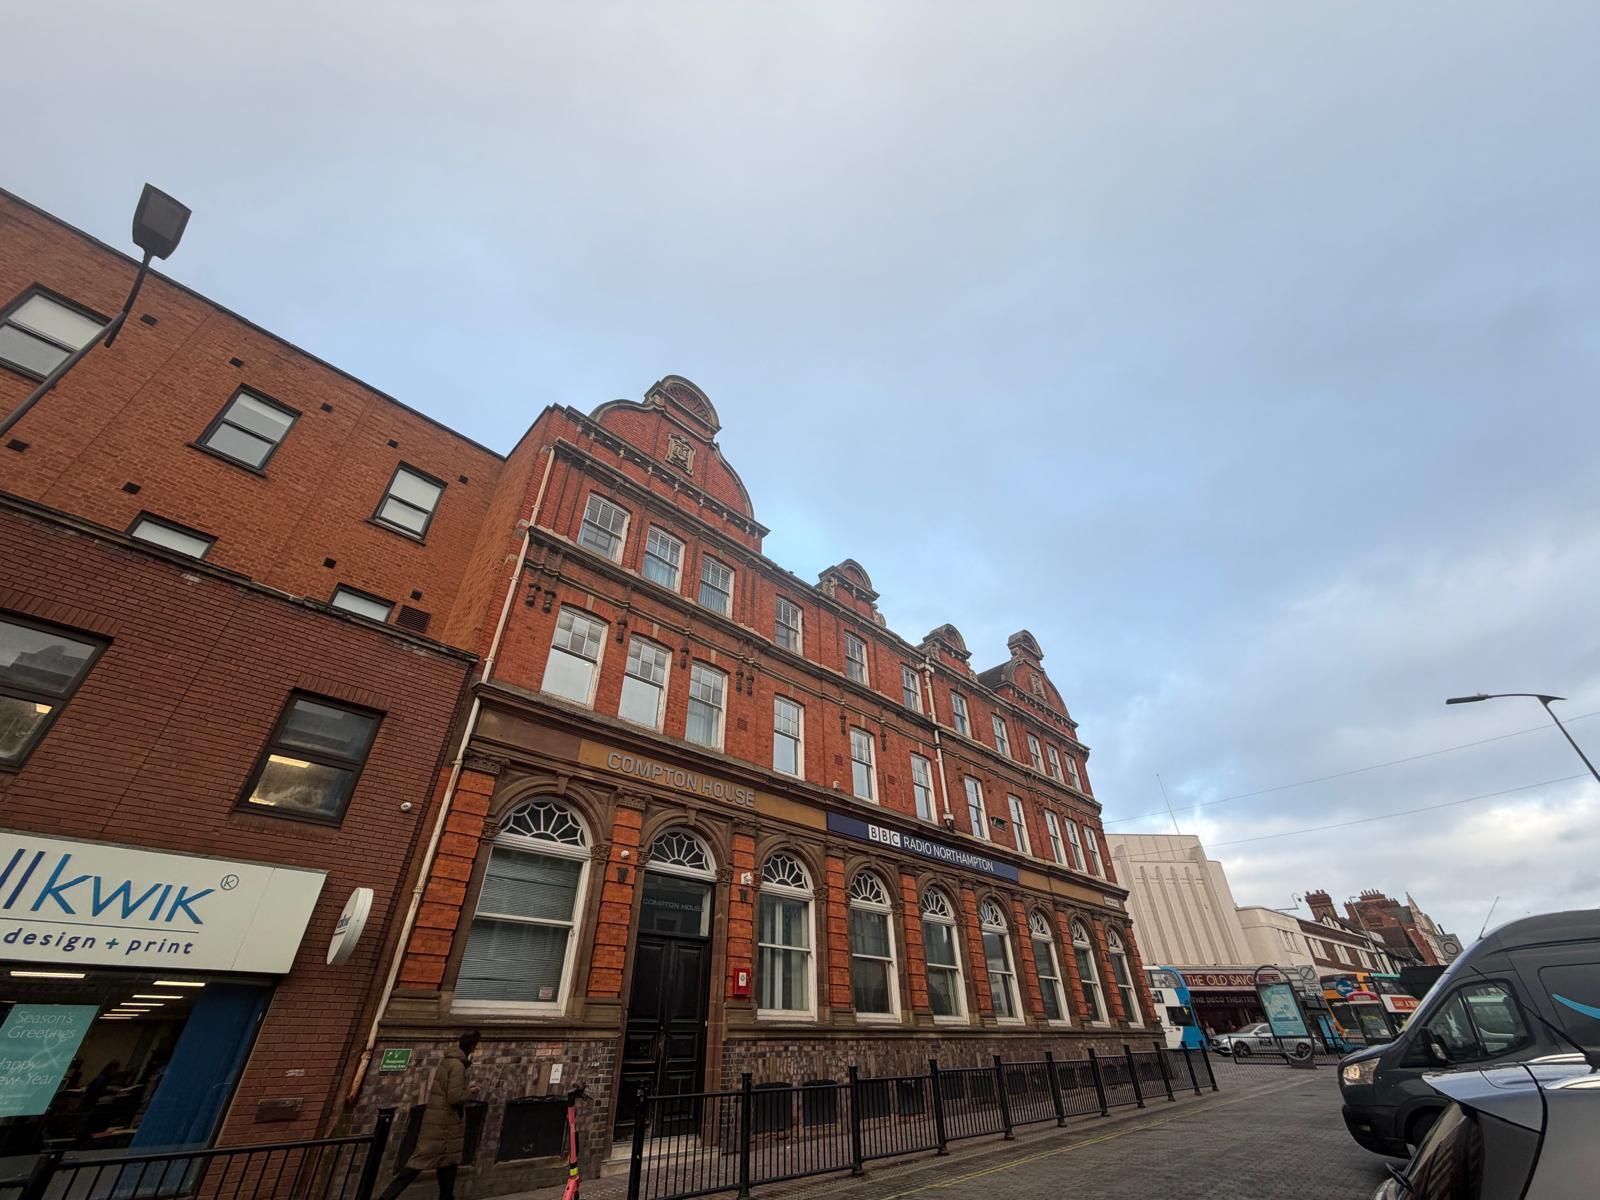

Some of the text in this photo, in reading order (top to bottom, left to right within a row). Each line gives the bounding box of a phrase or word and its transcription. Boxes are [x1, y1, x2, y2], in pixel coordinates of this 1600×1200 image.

[607, 751, 756, 808] COMPTON HOUSE
[869, 824, 994, 872] BBC RADIO NORTHAMPTON
[3, 927, 97, 953] design
[125, 938, 194, 955] print
[1186, 974, 1205, 987] THE
[1206, 974, 1228, 987] OLD
[16, 1010, 76, 1024] Season's
[7, 1025, 77, 1043] Greetings
[24, 1071, 54, 1087] Year
